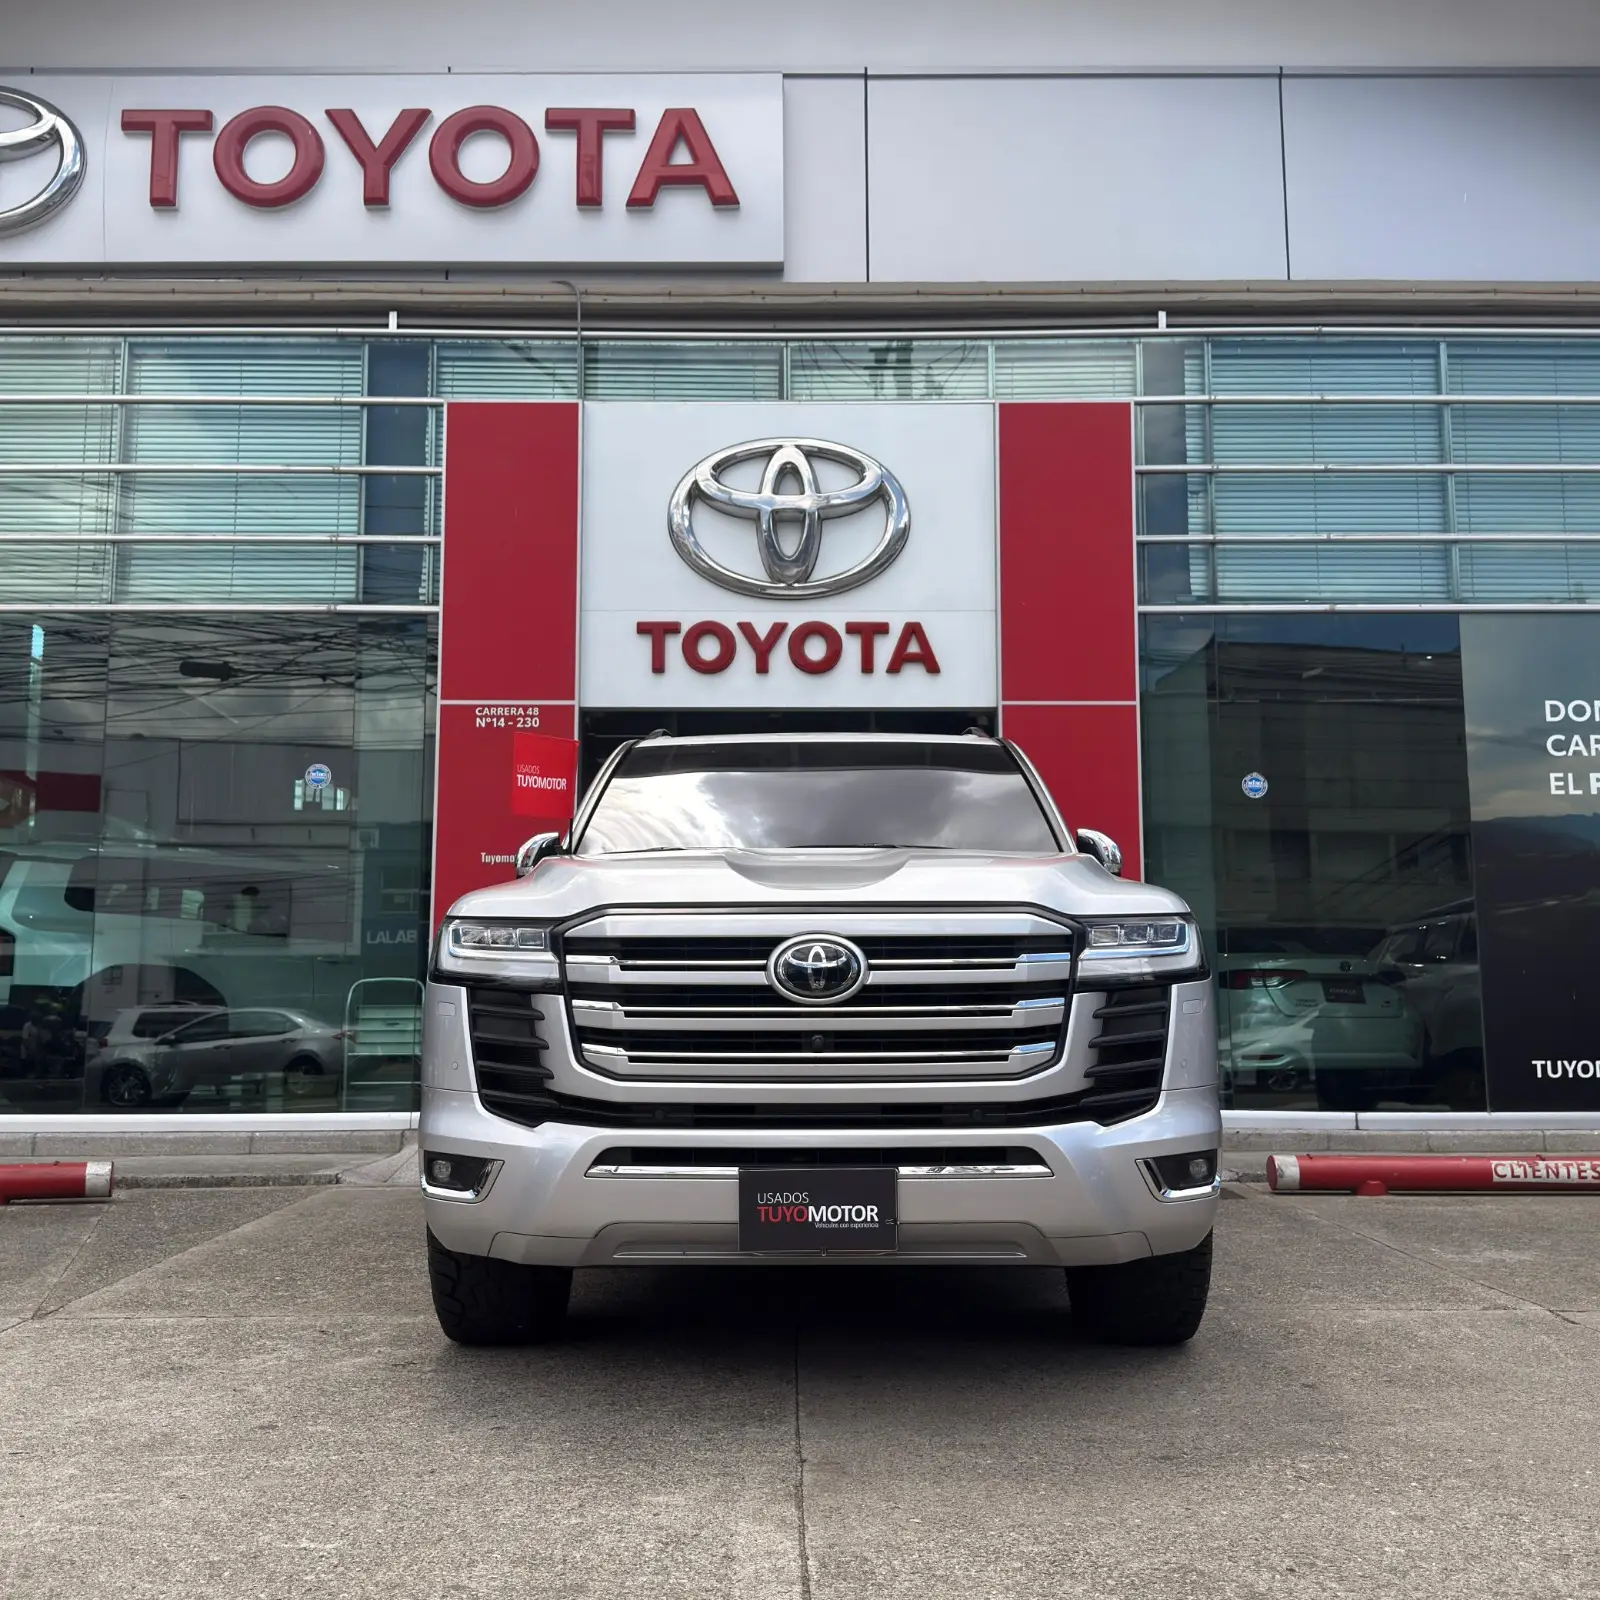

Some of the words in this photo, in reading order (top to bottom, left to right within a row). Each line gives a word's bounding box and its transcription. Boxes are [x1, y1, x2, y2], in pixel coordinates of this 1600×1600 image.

[121, 105, 740, 211] TOYOTA
[636, 620, 941, 674] TOYOTA
[475, 707, 525, 716] CARRERA
[526, 707, 540, 716] 48
[516, 717, 540, 728] 230
[516, 764, 540, 775] USADOS
[516, 774, 567, 790] TUYOMOTOR
[1549, 772, 1583, 795] EL
[480, 852, 516, 865] Tuyomo
[757, 1192, 809, 1204] USADOS
[757, 1205, 879, 1222] TUYOMOTOR
